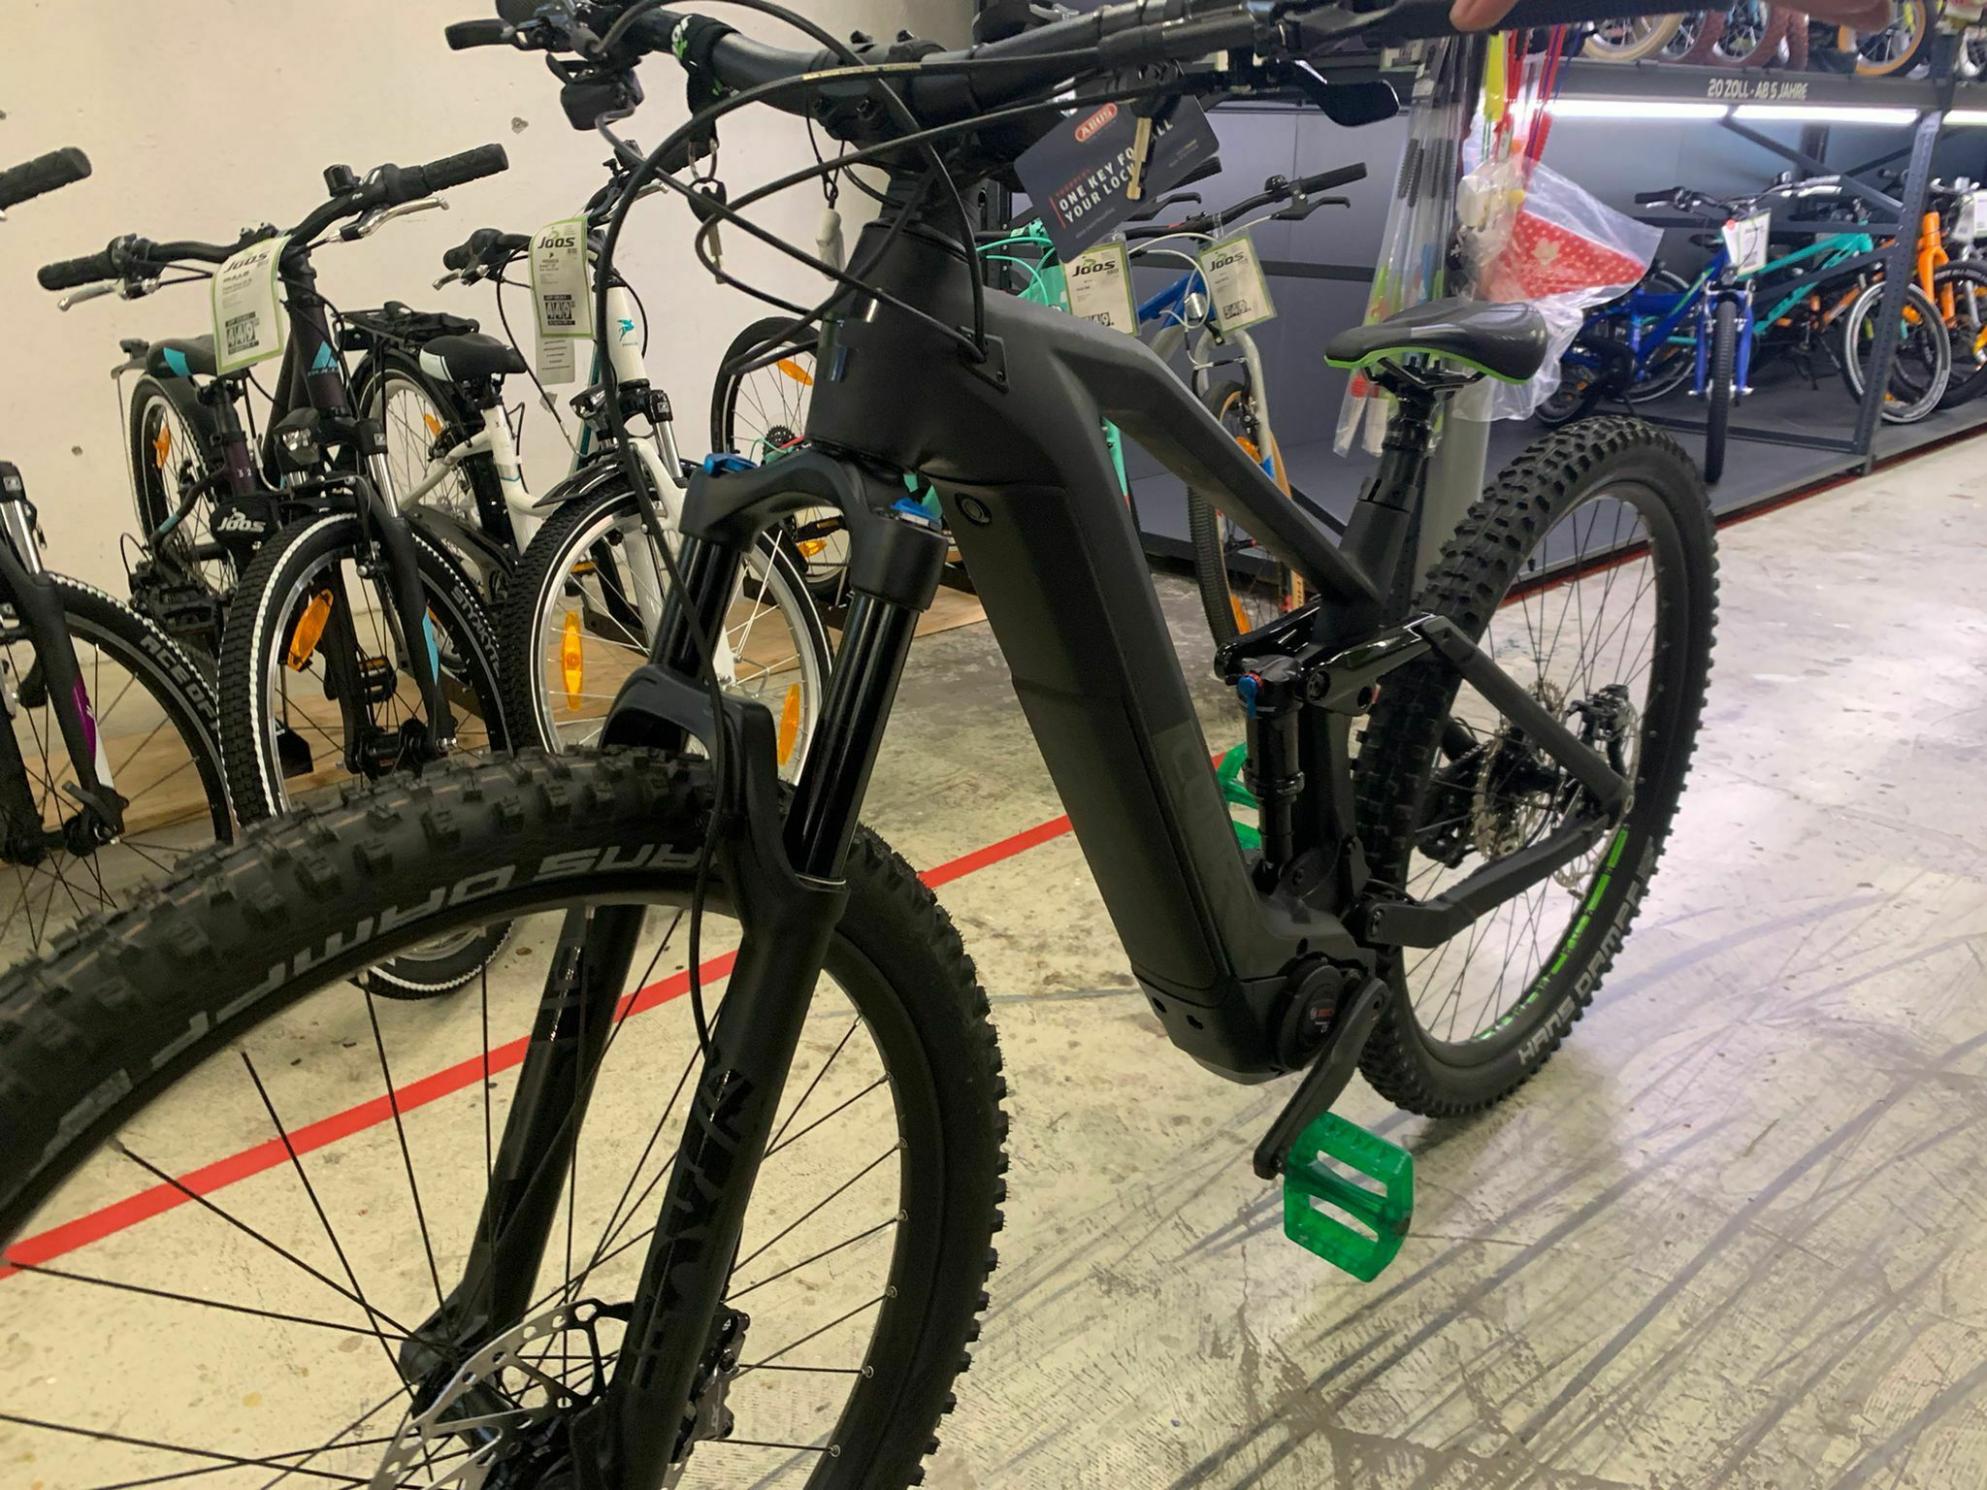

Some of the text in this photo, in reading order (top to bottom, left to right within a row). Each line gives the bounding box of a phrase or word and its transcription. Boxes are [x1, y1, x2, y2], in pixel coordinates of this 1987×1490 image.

[1707, 78, 1724, 97] 20
[1723, 79, 1749, 98] ZOLL
[1754, 80, 1770, 99] AB
[1770, 81, 1779, 99] 5
[1777, 81, 1809, 101] JAHRE
[1079, 107, 1115, 136] ABUS
[1059, 185, 1087, 211] ONE
[1088, 161, 1115, 188] KEY
[1065, 194, 1101, 223] YOUR
[140, 634, 191, 685] ACE
[532, 843, 708, 882] ANS
[1517, 880, 1642, 1066] HANS DAMPF
